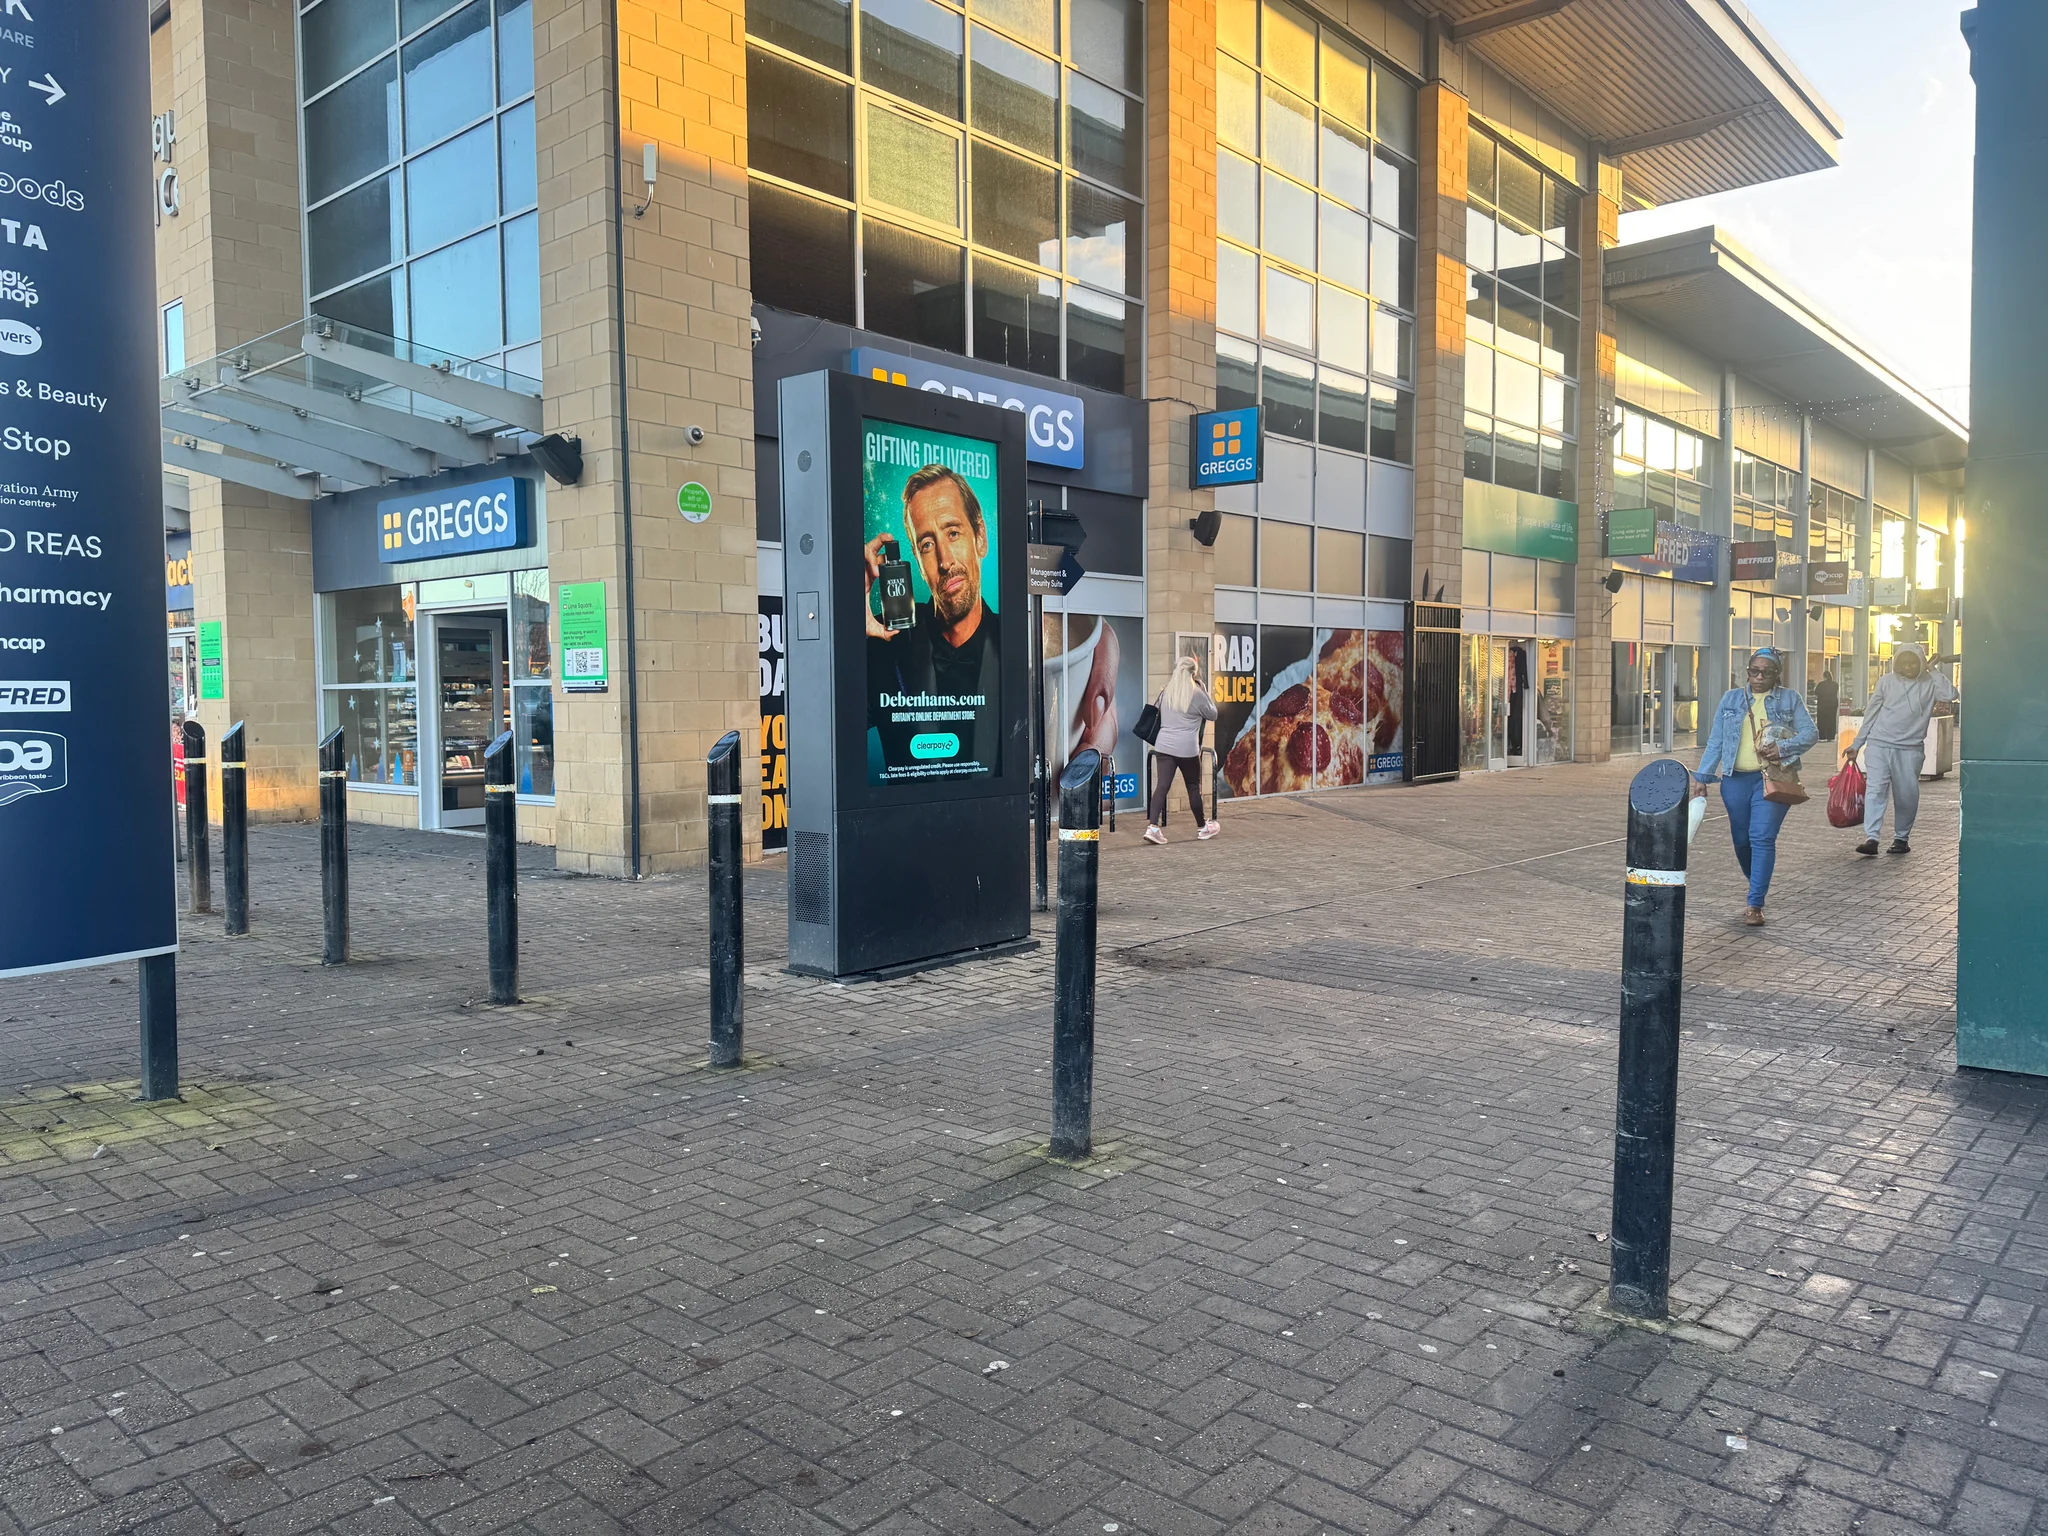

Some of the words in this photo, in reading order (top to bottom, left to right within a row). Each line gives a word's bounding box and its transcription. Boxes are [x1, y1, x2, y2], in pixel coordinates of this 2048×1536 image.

[0, 110, 12, 121] e
[0, 217, 49, 251] TA
[16, 379, 33, 399] &
[38, 382, 108, 413] Beauty
[0, 426, 72, 461] Stop
[865, 431, 920, 469] GIFTING
[923, 442, 991, 480] DELIVERED
[1200, 457, 1253, 476] GREGGS
[42, 484, 80, 503] Army
[406, 492, 509, 545] GREGGS
[27, 531, 102, 559] REAS
[1641, 536, 1690, 566] TFRED
[1737, 556, 1774, 565] BETFRED
[1030, 567, 1062, 578] Management
[1062, 569, 1068, 577] &
[1816, 571, 1844, 580] mencap
[1030, 578, 1050, 588] Security
[1050, 579, 1064, 588] Suite
[1213, 634, 1255, 672] RAB
[1214, 675, 1255, 703] SLICE
[879, 690, 986, 708] Debenhams.com
[891, 712, 915, 722] BRITAIN'S
[915, 711, 933, 721] ONLINE
[933, 711, 962, 721] DEPARTMENT
[962, 710, 976, 720] STORE
[916, 741, 946, 751] clearpay
[29, 772, 47, 780] taste
